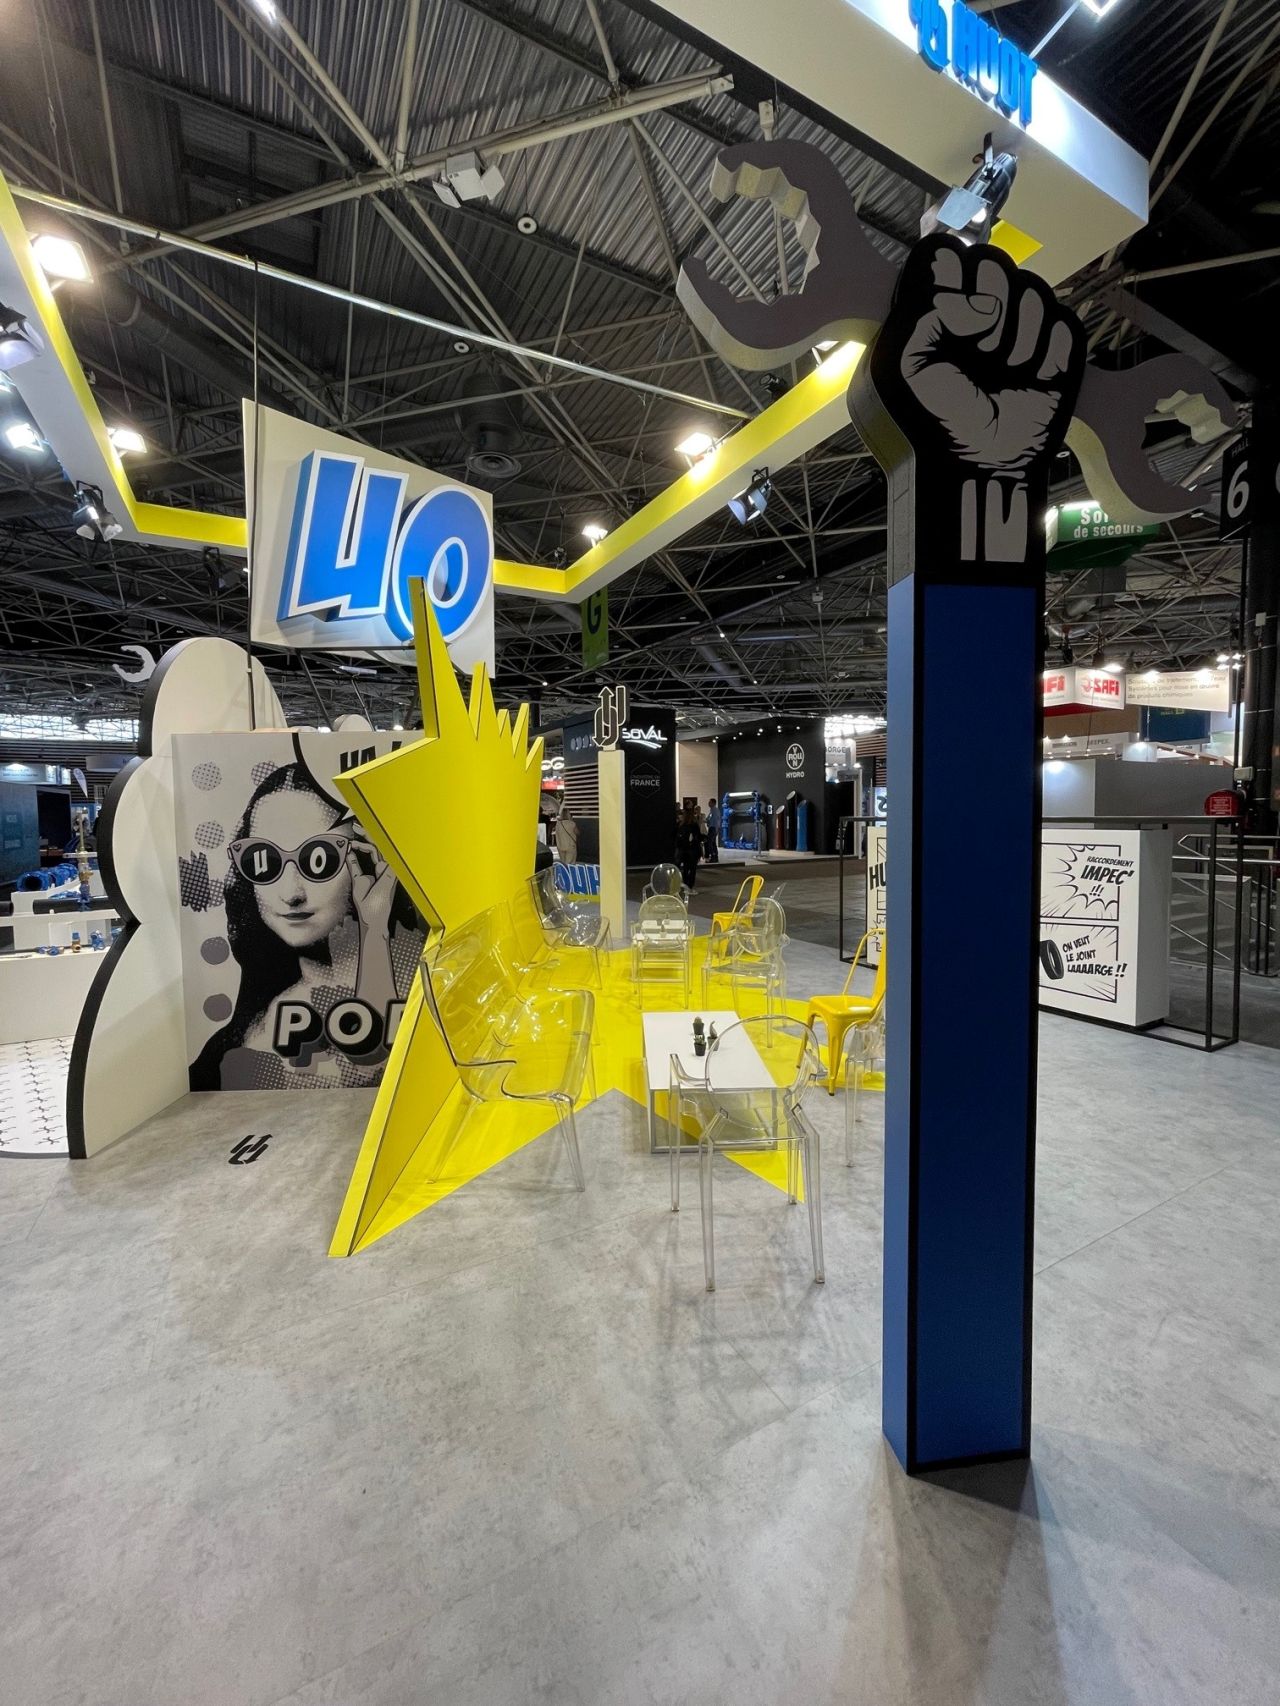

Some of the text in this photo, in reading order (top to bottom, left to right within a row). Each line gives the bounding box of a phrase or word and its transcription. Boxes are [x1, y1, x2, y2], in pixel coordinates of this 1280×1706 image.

[951, 0, 1039, 129] HUOT
[1227, 460, 1250, 518] 6
[1073, 524, 1144, 538] de secours
[622, 725, 668, 741] SOVAL
[630, 779, 661, 787] FRANCE
[1087, 856, 1134, 867] RACCORDEMENT
[1080, 865, 1135, 885] IMPEC'
[1089, 884, 1104, 897] !!!
[1062, 935, 1090, 953] ON VEUT
[1066, 949, 1096, 962] LE JOINT
